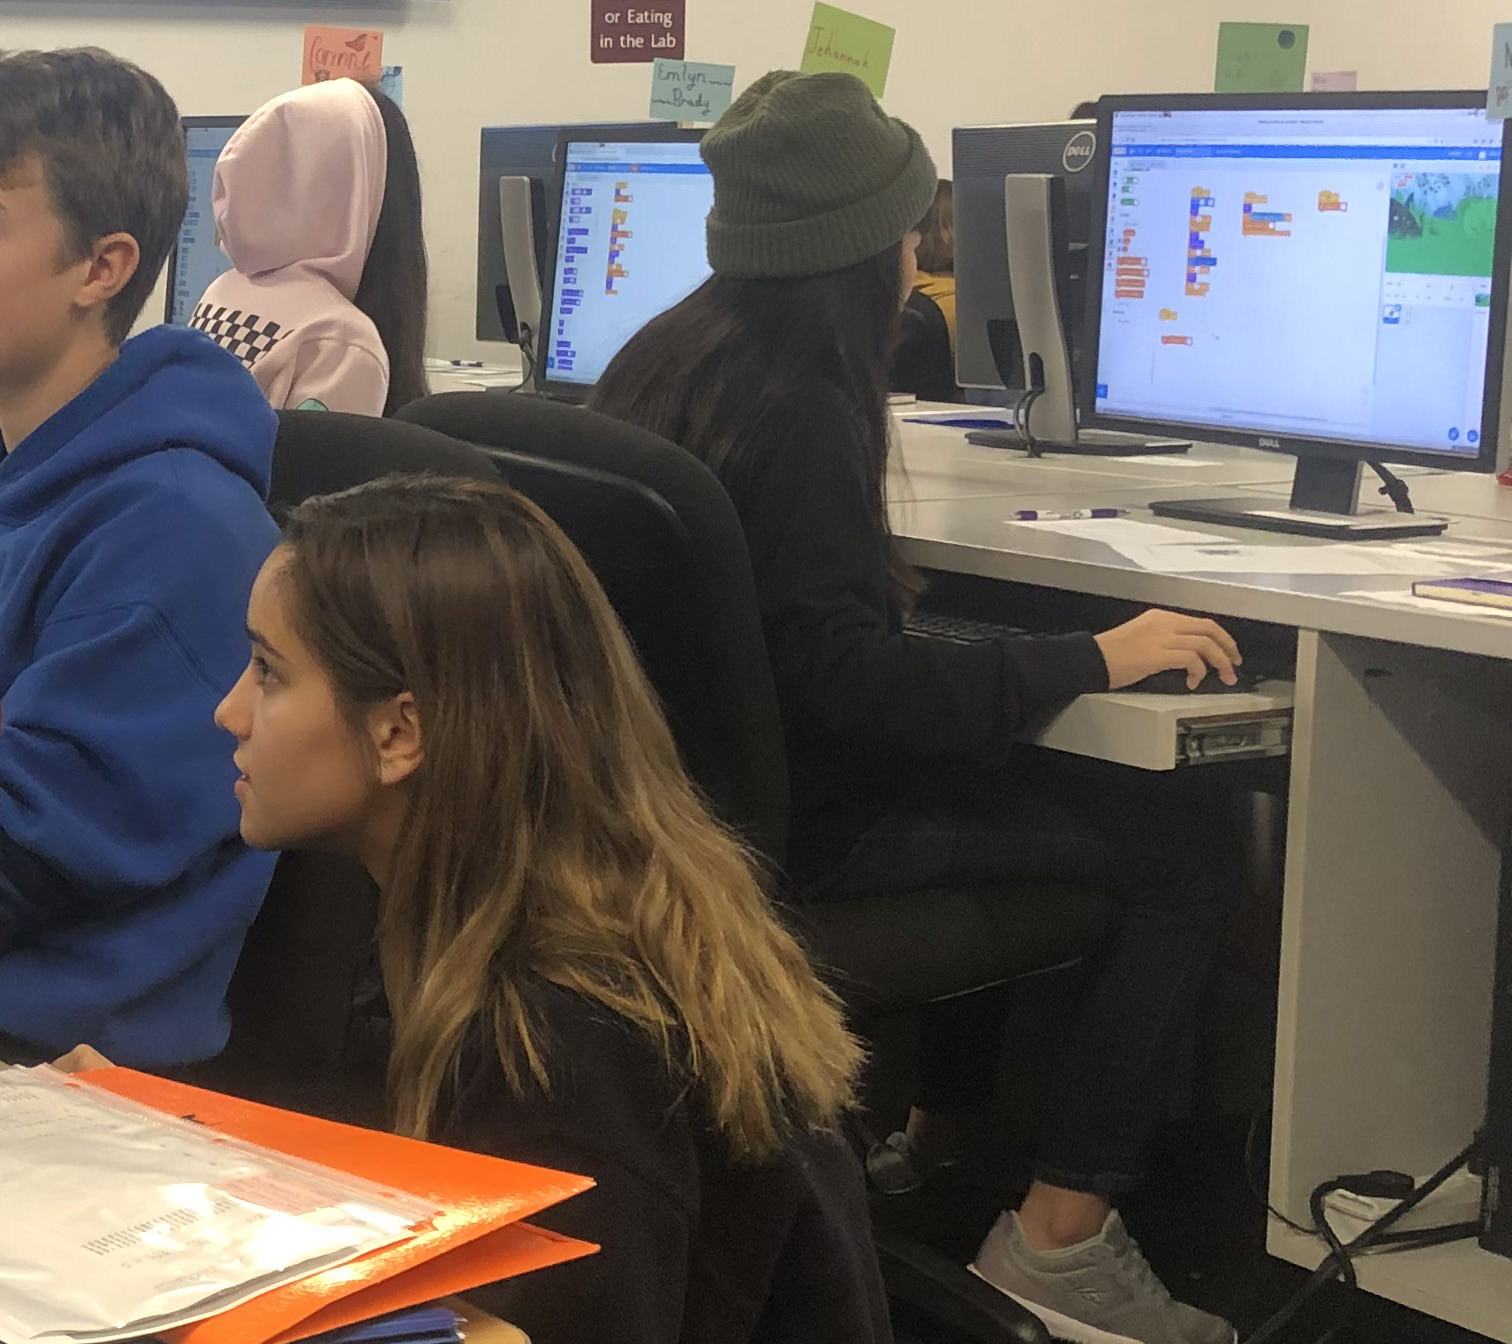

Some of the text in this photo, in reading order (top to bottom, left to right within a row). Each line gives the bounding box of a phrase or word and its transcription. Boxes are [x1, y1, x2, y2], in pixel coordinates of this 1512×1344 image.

[605, 9, 673, 28] or Eating
[600, 32, 676, 48] in the Lab
